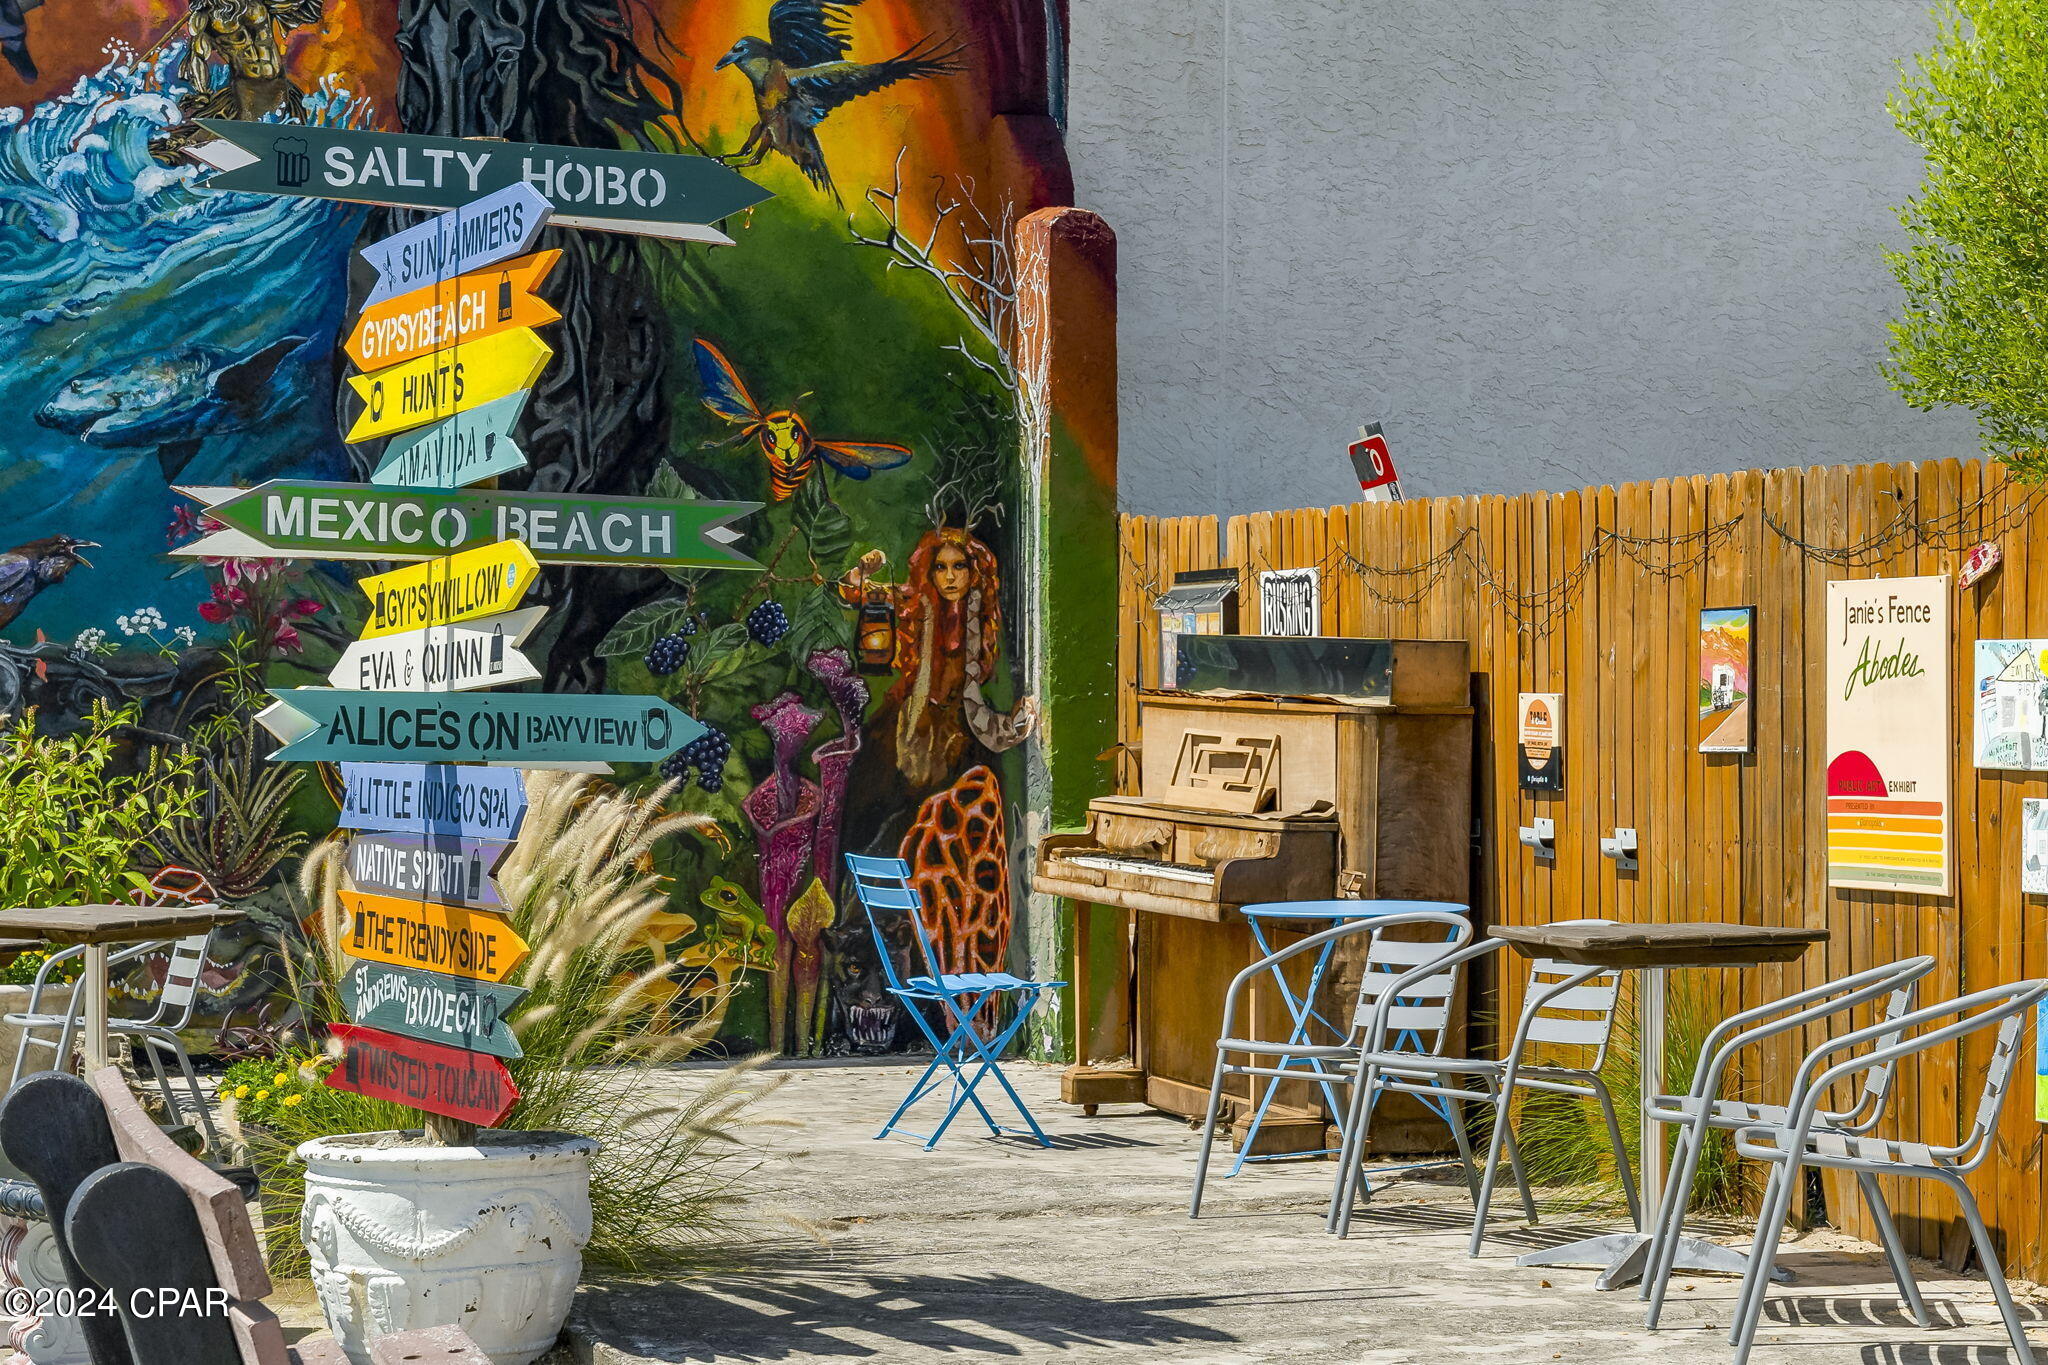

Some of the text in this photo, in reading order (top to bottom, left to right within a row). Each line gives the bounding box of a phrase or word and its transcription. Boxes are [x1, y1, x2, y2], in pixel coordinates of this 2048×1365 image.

[324, 145, 667, 208] SALTY HOBO
[402, 202, 523, 283] SUNJAMMERS
[362, 290, 486, 359] GYPSYBEACH
[398, 427, 476, 486] AMAVIDA
[266, 496, 671, 554] MEXICO BEACH
[387, 562, 502, 627] GYPSYWILLOW
[1265, 581, 1312, 637] BUSKING
[1843, 595, 1931, 646] Janie's Fence
[360, 637, 483, 691] EVA & QUINN
[1845, 636, 1925, 701] Abodes
[327, 701, 637, 750] ALICE'S ON BAYVIEW
[358, 777, 509, 828] LITTLE INDIGO SPA
[1838, 780, 1917, 793] PUBLIC ART EXHIBIT
[355, 842, 463, 896] NATIVE SPIRIT
[366, 910, 496, 974] THE TRENDY SIDE
[355, 965, 369, 995] ST
[355, 973, 407, 1023] ANDREWS
[405, 986, 480, 1036] BODEGA
[358, 1041, 500, 1112] TWISTED TOUCAN
